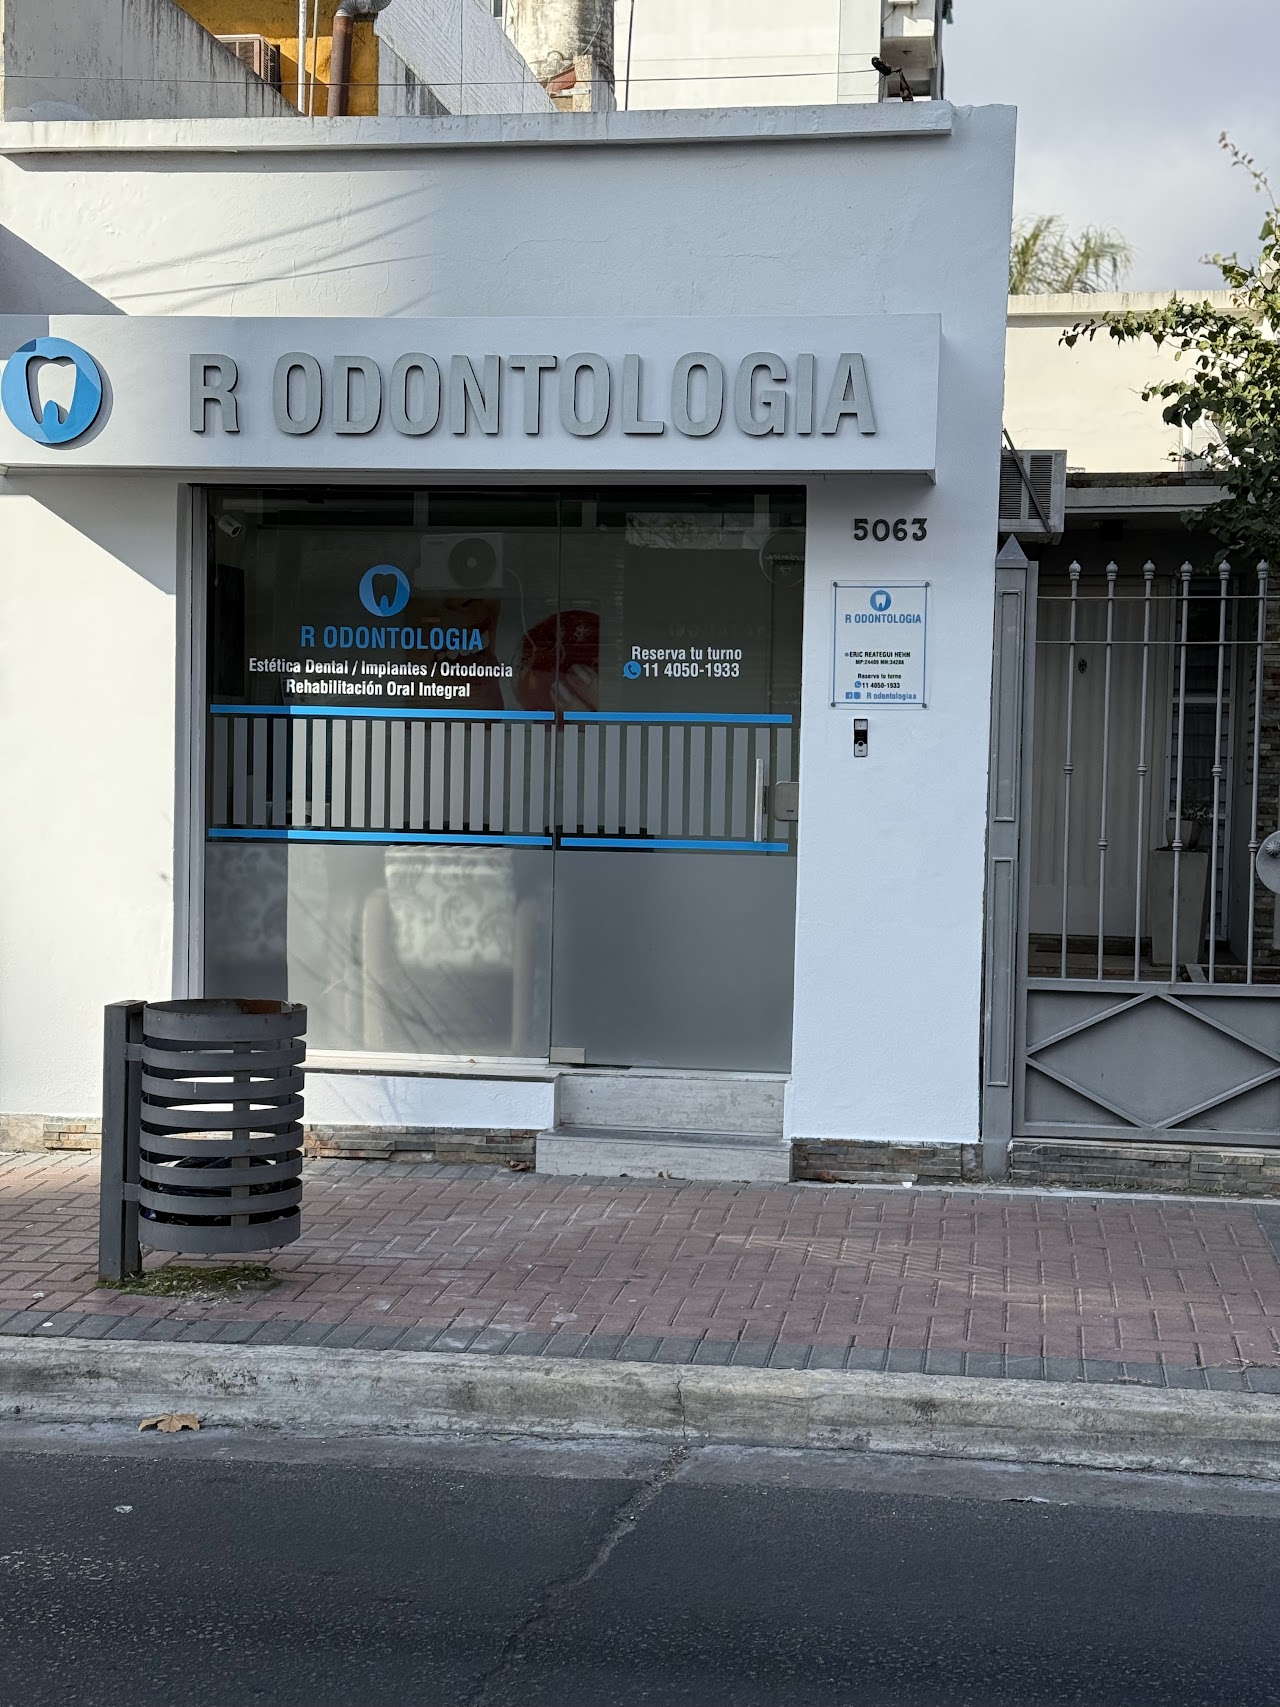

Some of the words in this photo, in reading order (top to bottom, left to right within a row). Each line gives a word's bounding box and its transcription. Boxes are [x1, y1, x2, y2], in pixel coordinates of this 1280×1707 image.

[189, 353, 241, 434] R
[272, 351, 877, 438] ODONTOLOGIA
[853, 517, 928, 542] 5063
[845, 613, 852, 623] R
[855, 613, 922, 624] ODONTOLOGIA
[300, 625, 315, 648] R
[323, 626, 484, 651] ODONTOLOGIA
[631, 645, 686, 661] Reserva
[690, 646, 703, 661] tu
[707, 646, 742, 661] turno
[249, 657, 301, 674] Estética
[305, 658, 348, 675] Dental
[351, 660, 359, 676] /
[361, 660, 428, 679] Implantes
[430, 661, 438, 678] /
[440, 661, 513, 678] Ortodoncia
[642, 662, 659, 678] 11
[664, 662, 740, 678] 4050-1933
[286, 679, 383, 696] Rehabilitación
[386, 680, 415, 697] Oral
[419, 681, 471, 700] Integral
[866, 692, 872, 700] R
[873, 692, 917, 701] odontologiaa
